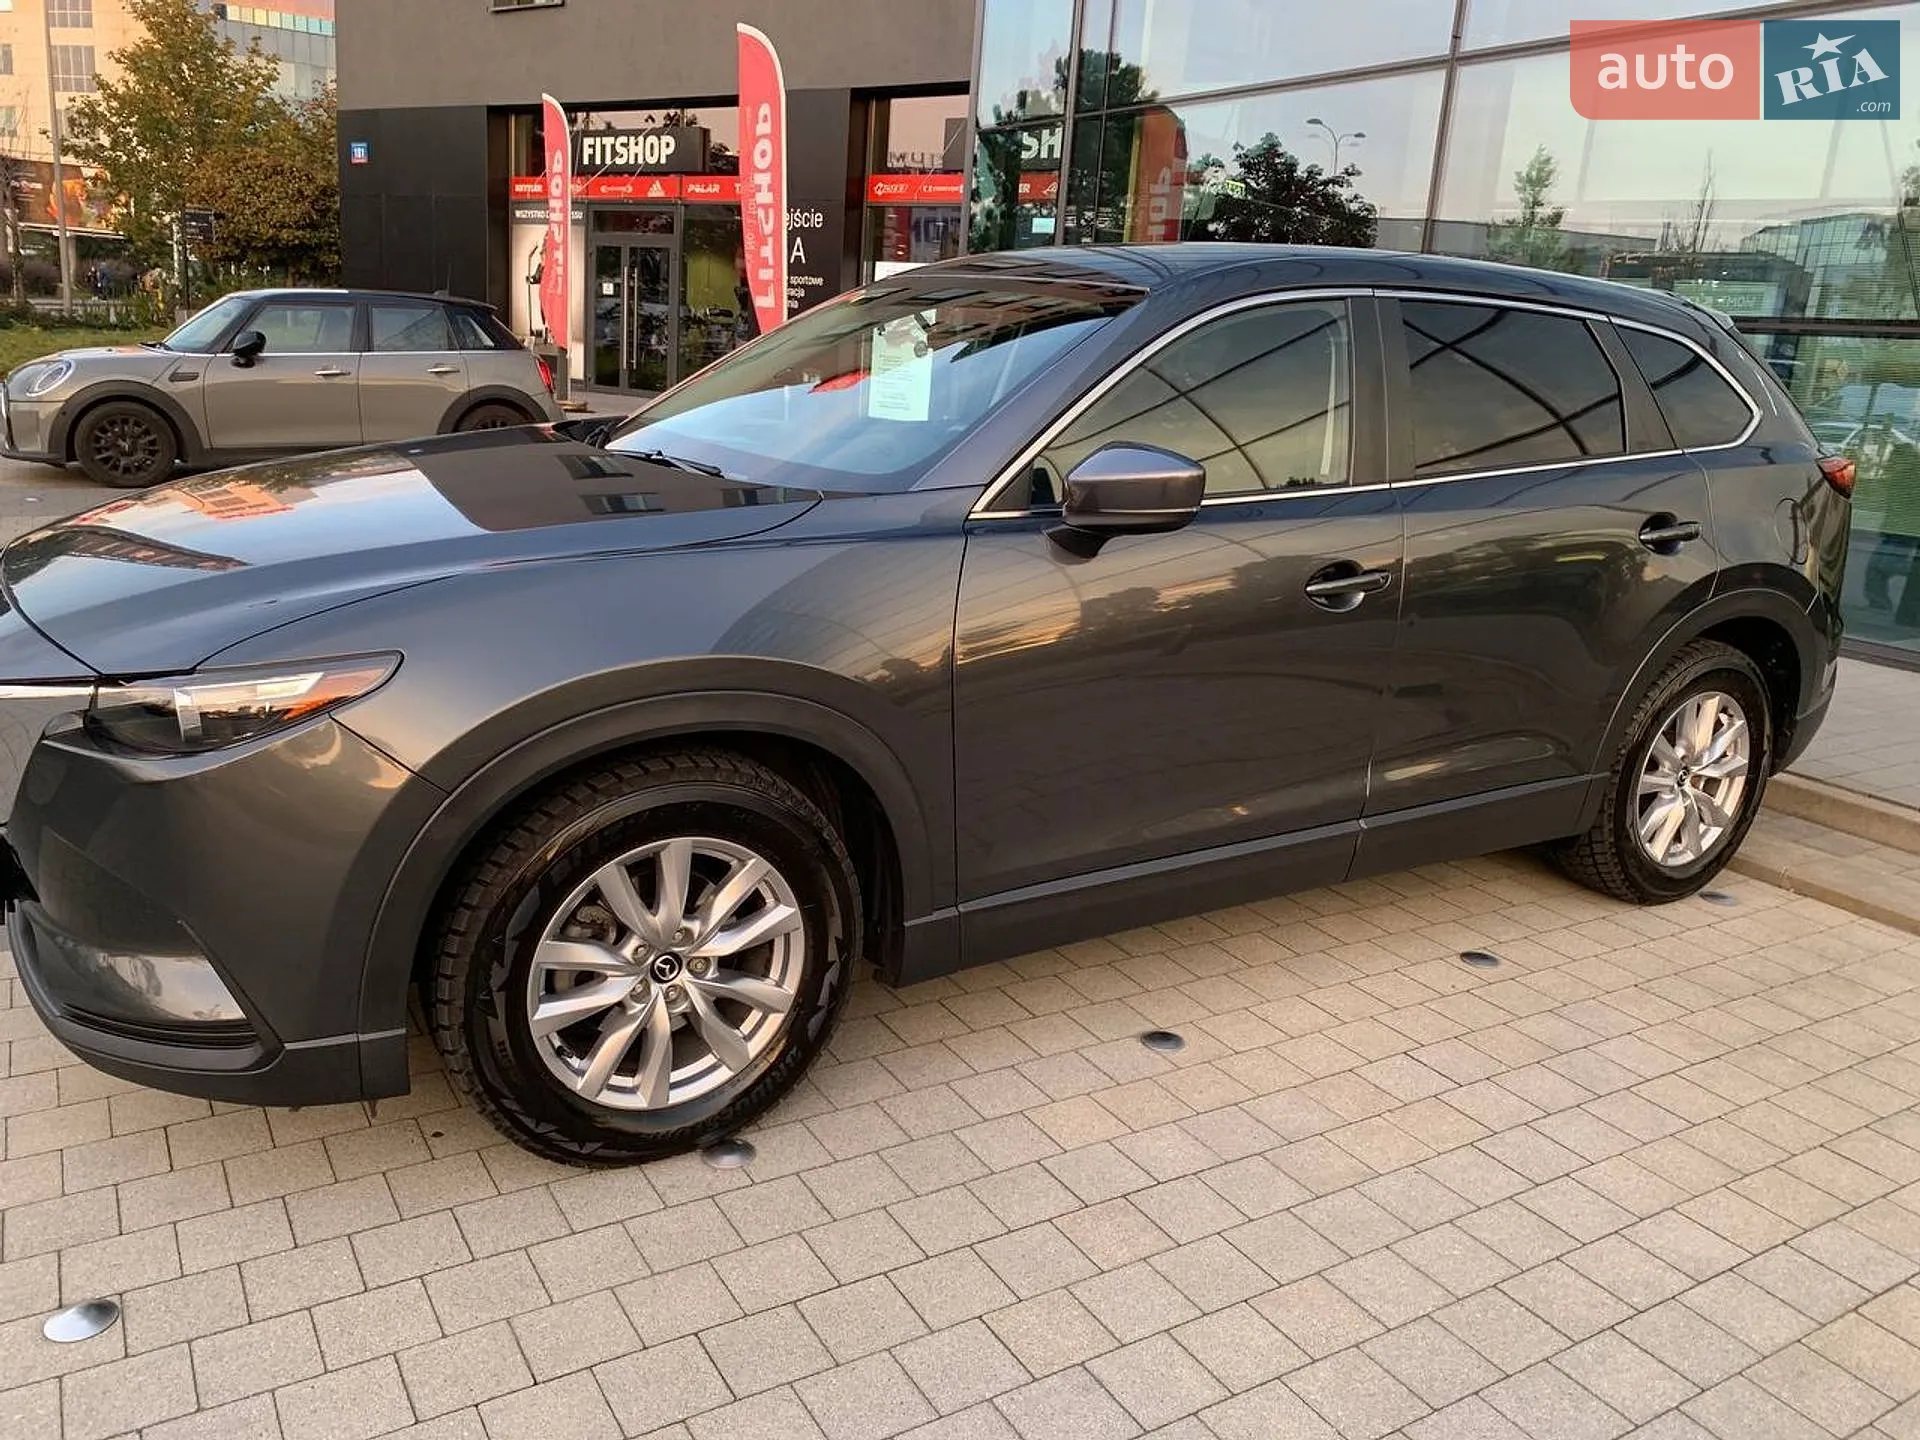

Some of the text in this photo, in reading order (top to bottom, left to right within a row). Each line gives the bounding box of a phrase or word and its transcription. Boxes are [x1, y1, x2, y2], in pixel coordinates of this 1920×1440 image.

[582, 135, 676, 166] FITSHOP
[687, 183, 721, 193] POLAR
[789, 236, 806, 264] A
